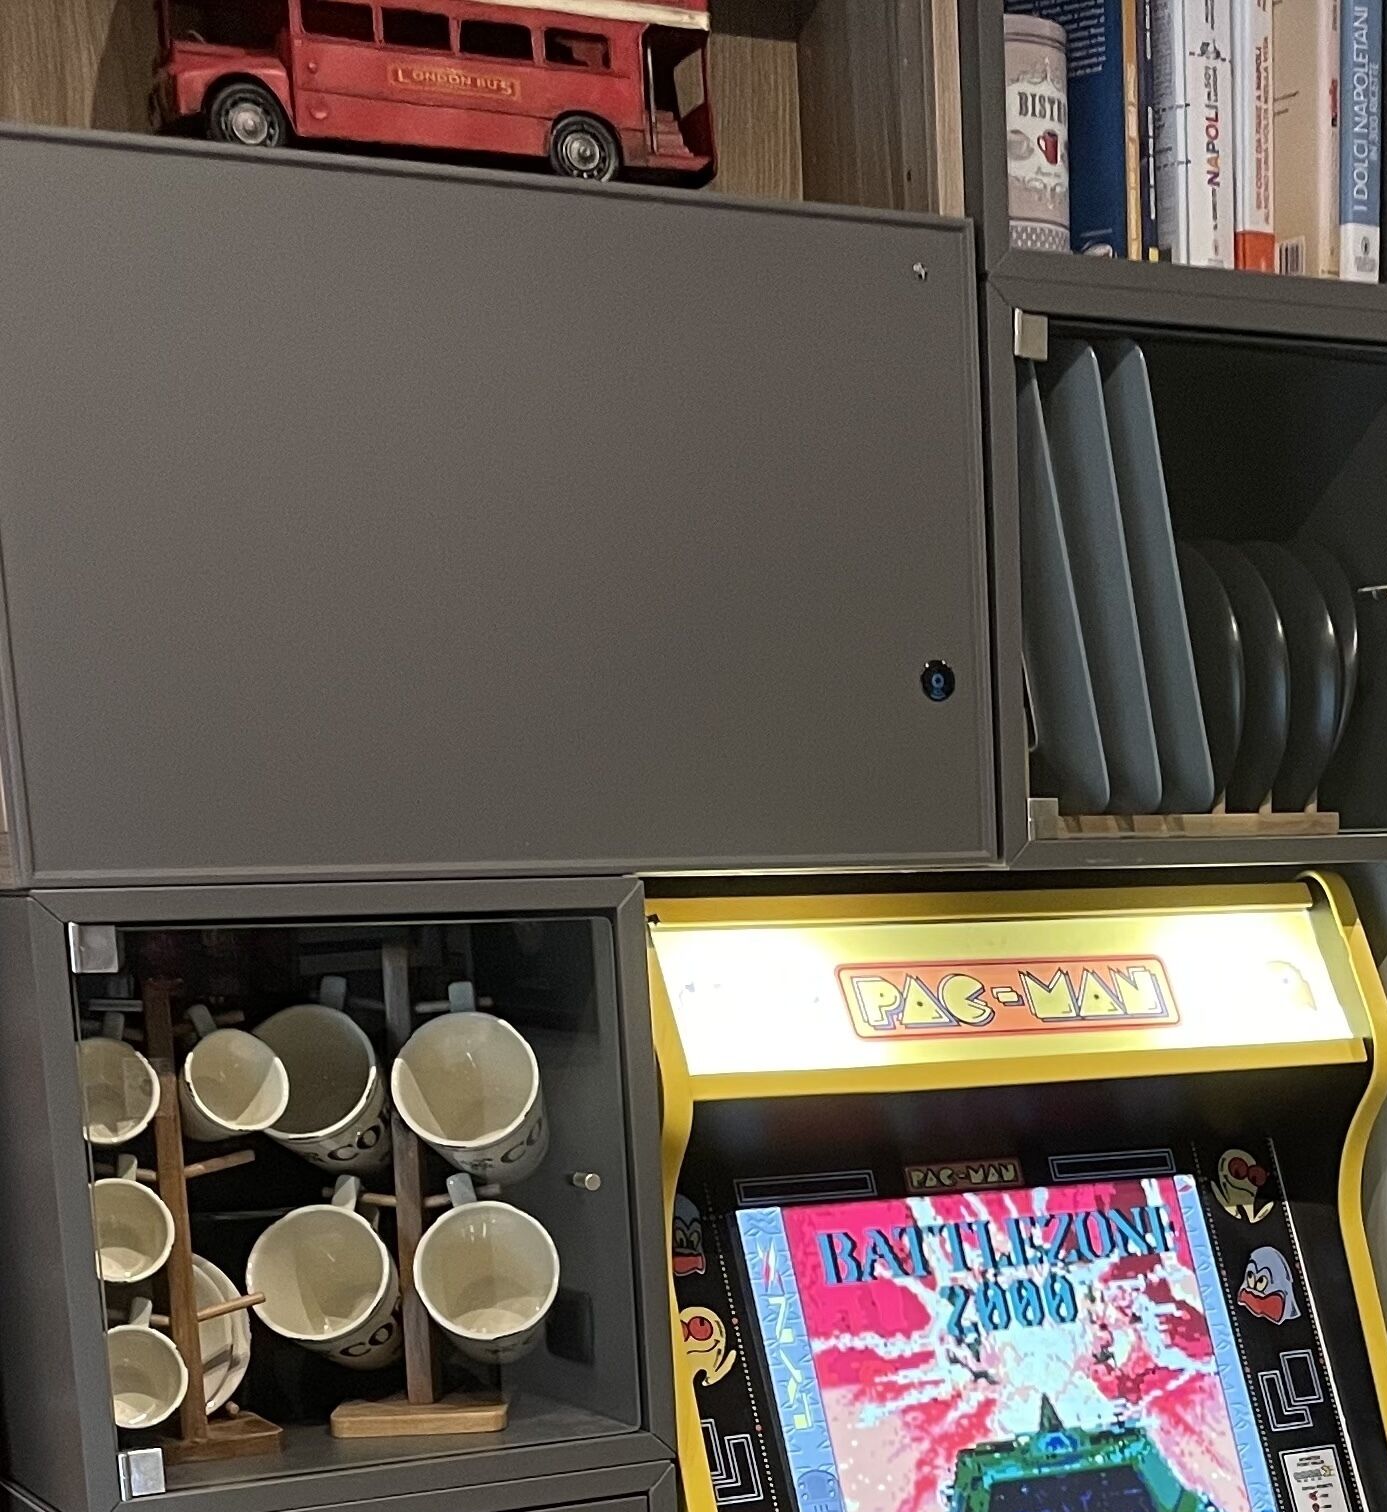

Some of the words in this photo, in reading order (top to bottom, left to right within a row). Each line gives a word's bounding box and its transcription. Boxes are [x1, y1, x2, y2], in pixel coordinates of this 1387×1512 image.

[1353, 5, 1369, 133] NAPOLETANI
[1353, 141, 1368, 200] DOLCI
[850, 966, 1169, 1031] PAC-MAN
[908, 1161, 1017, 1189] PAC-MAN
[815, 1204, 1176, 1285] BATTLEZONE
[938, 1273, 1080, 1348] 2000
